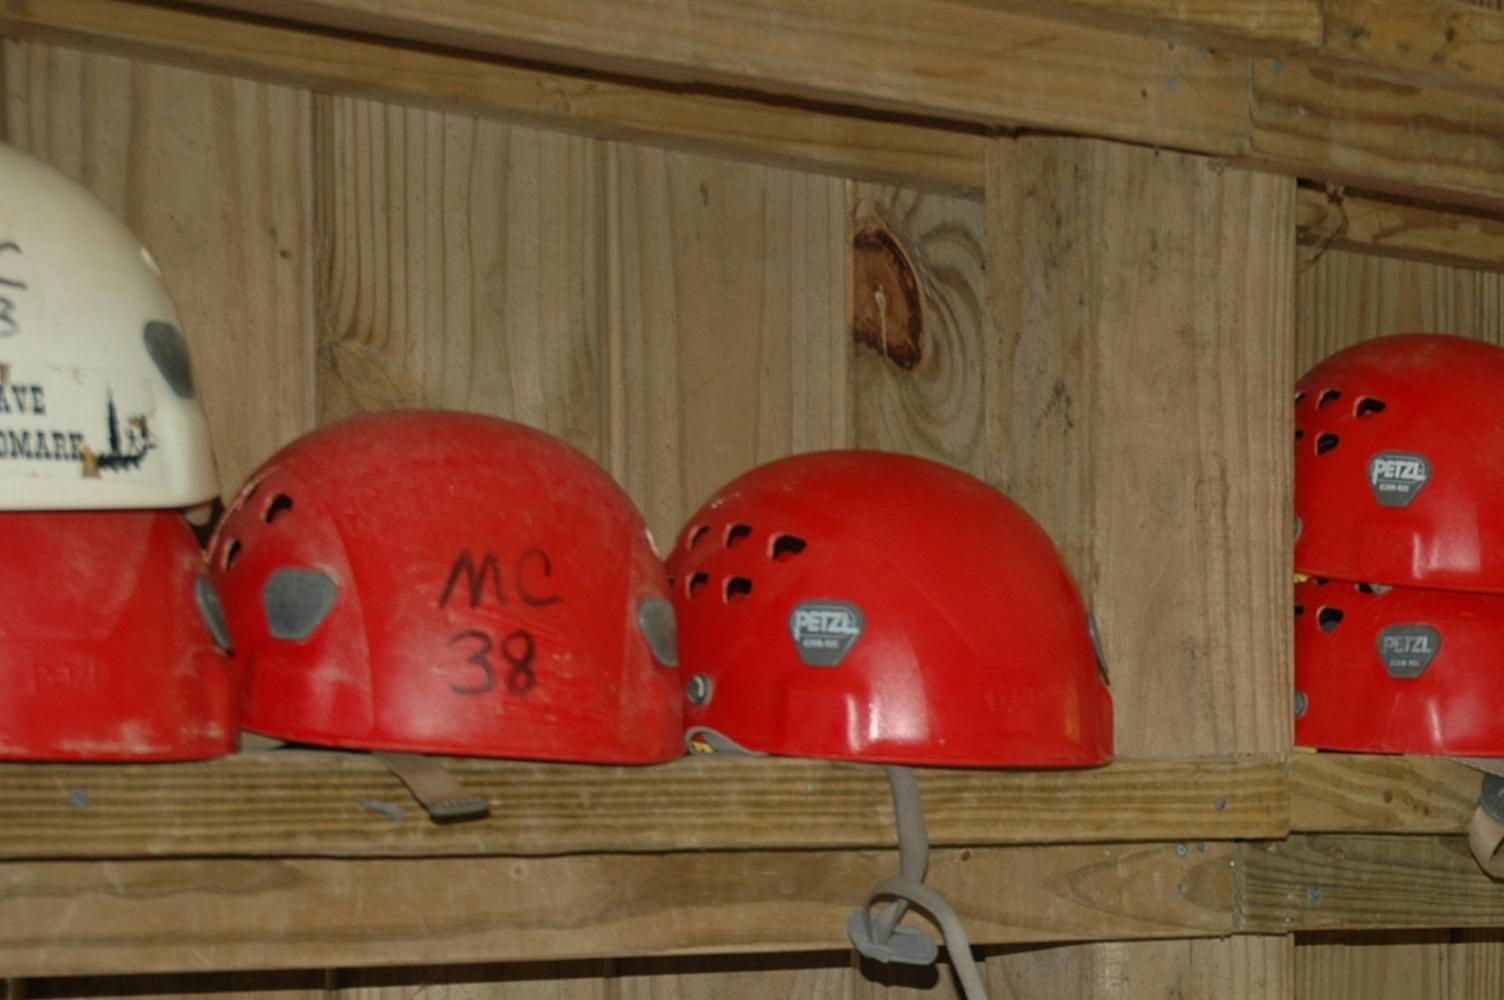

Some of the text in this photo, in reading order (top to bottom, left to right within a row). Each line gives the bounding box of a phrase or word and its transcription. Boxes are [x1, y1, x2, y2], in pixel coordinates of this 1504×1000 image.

[1373, 459, 1427, 485] PETZL
[437, 548, 560, 609] MC
[793, 610, 860, 641] PETZL
[1384, 636, 1431, 656] PETZL
[446, 630, 536, 696] 38
